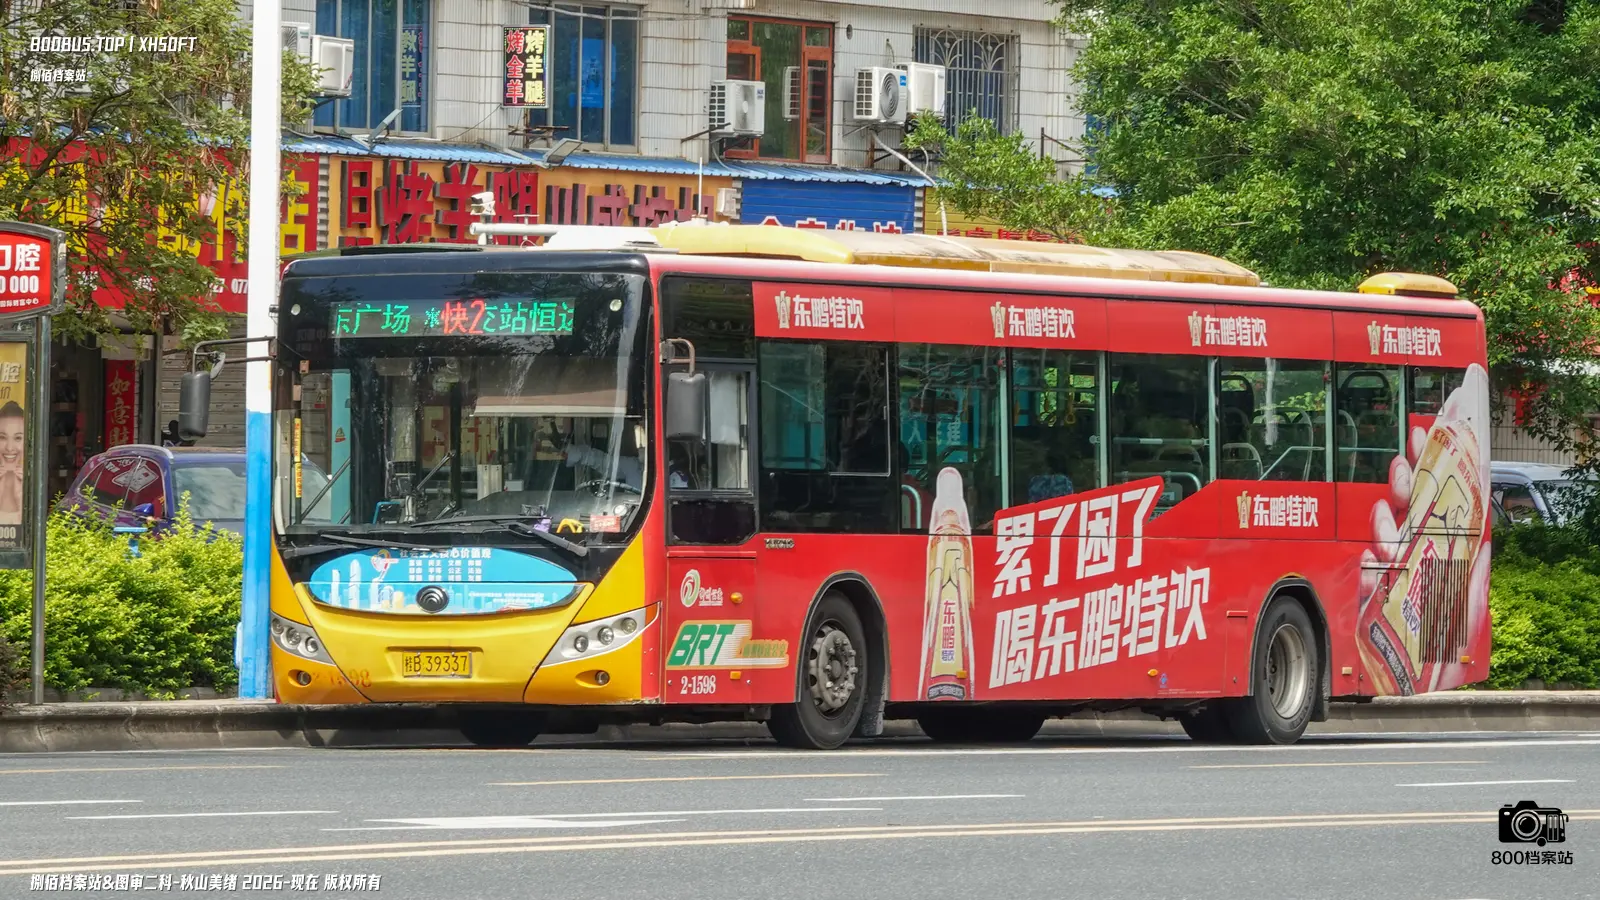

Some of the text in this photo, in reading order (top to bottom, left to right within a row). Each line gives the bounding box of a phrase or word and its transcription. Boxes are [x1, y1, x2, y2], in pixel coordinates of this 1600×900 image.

[506, 29, 525, 105] 烤全羊
[525, 29, 545, 104] 烤羊腿
[441, 299, 486, 335] 快2
[792, 294, 865, 330] 东鹏特饮
[1008, 304, 1076, 339] 东鹏特饮
[1203, 314, 1268, 347] 东鹏特饮
[1382, 324, 1442, 357] 东鹏特饮
[0, 361, 21, 382] 腔
[1253, 493, 1319, 528] 东鹏特饮
[991, 485, 1161, 599] 累了困了
[667, 623, 737, 667] BRT
[988, 566, 1211, 690] 喝东鹏特饮
[680, 675, 717, 695] 2-1598
